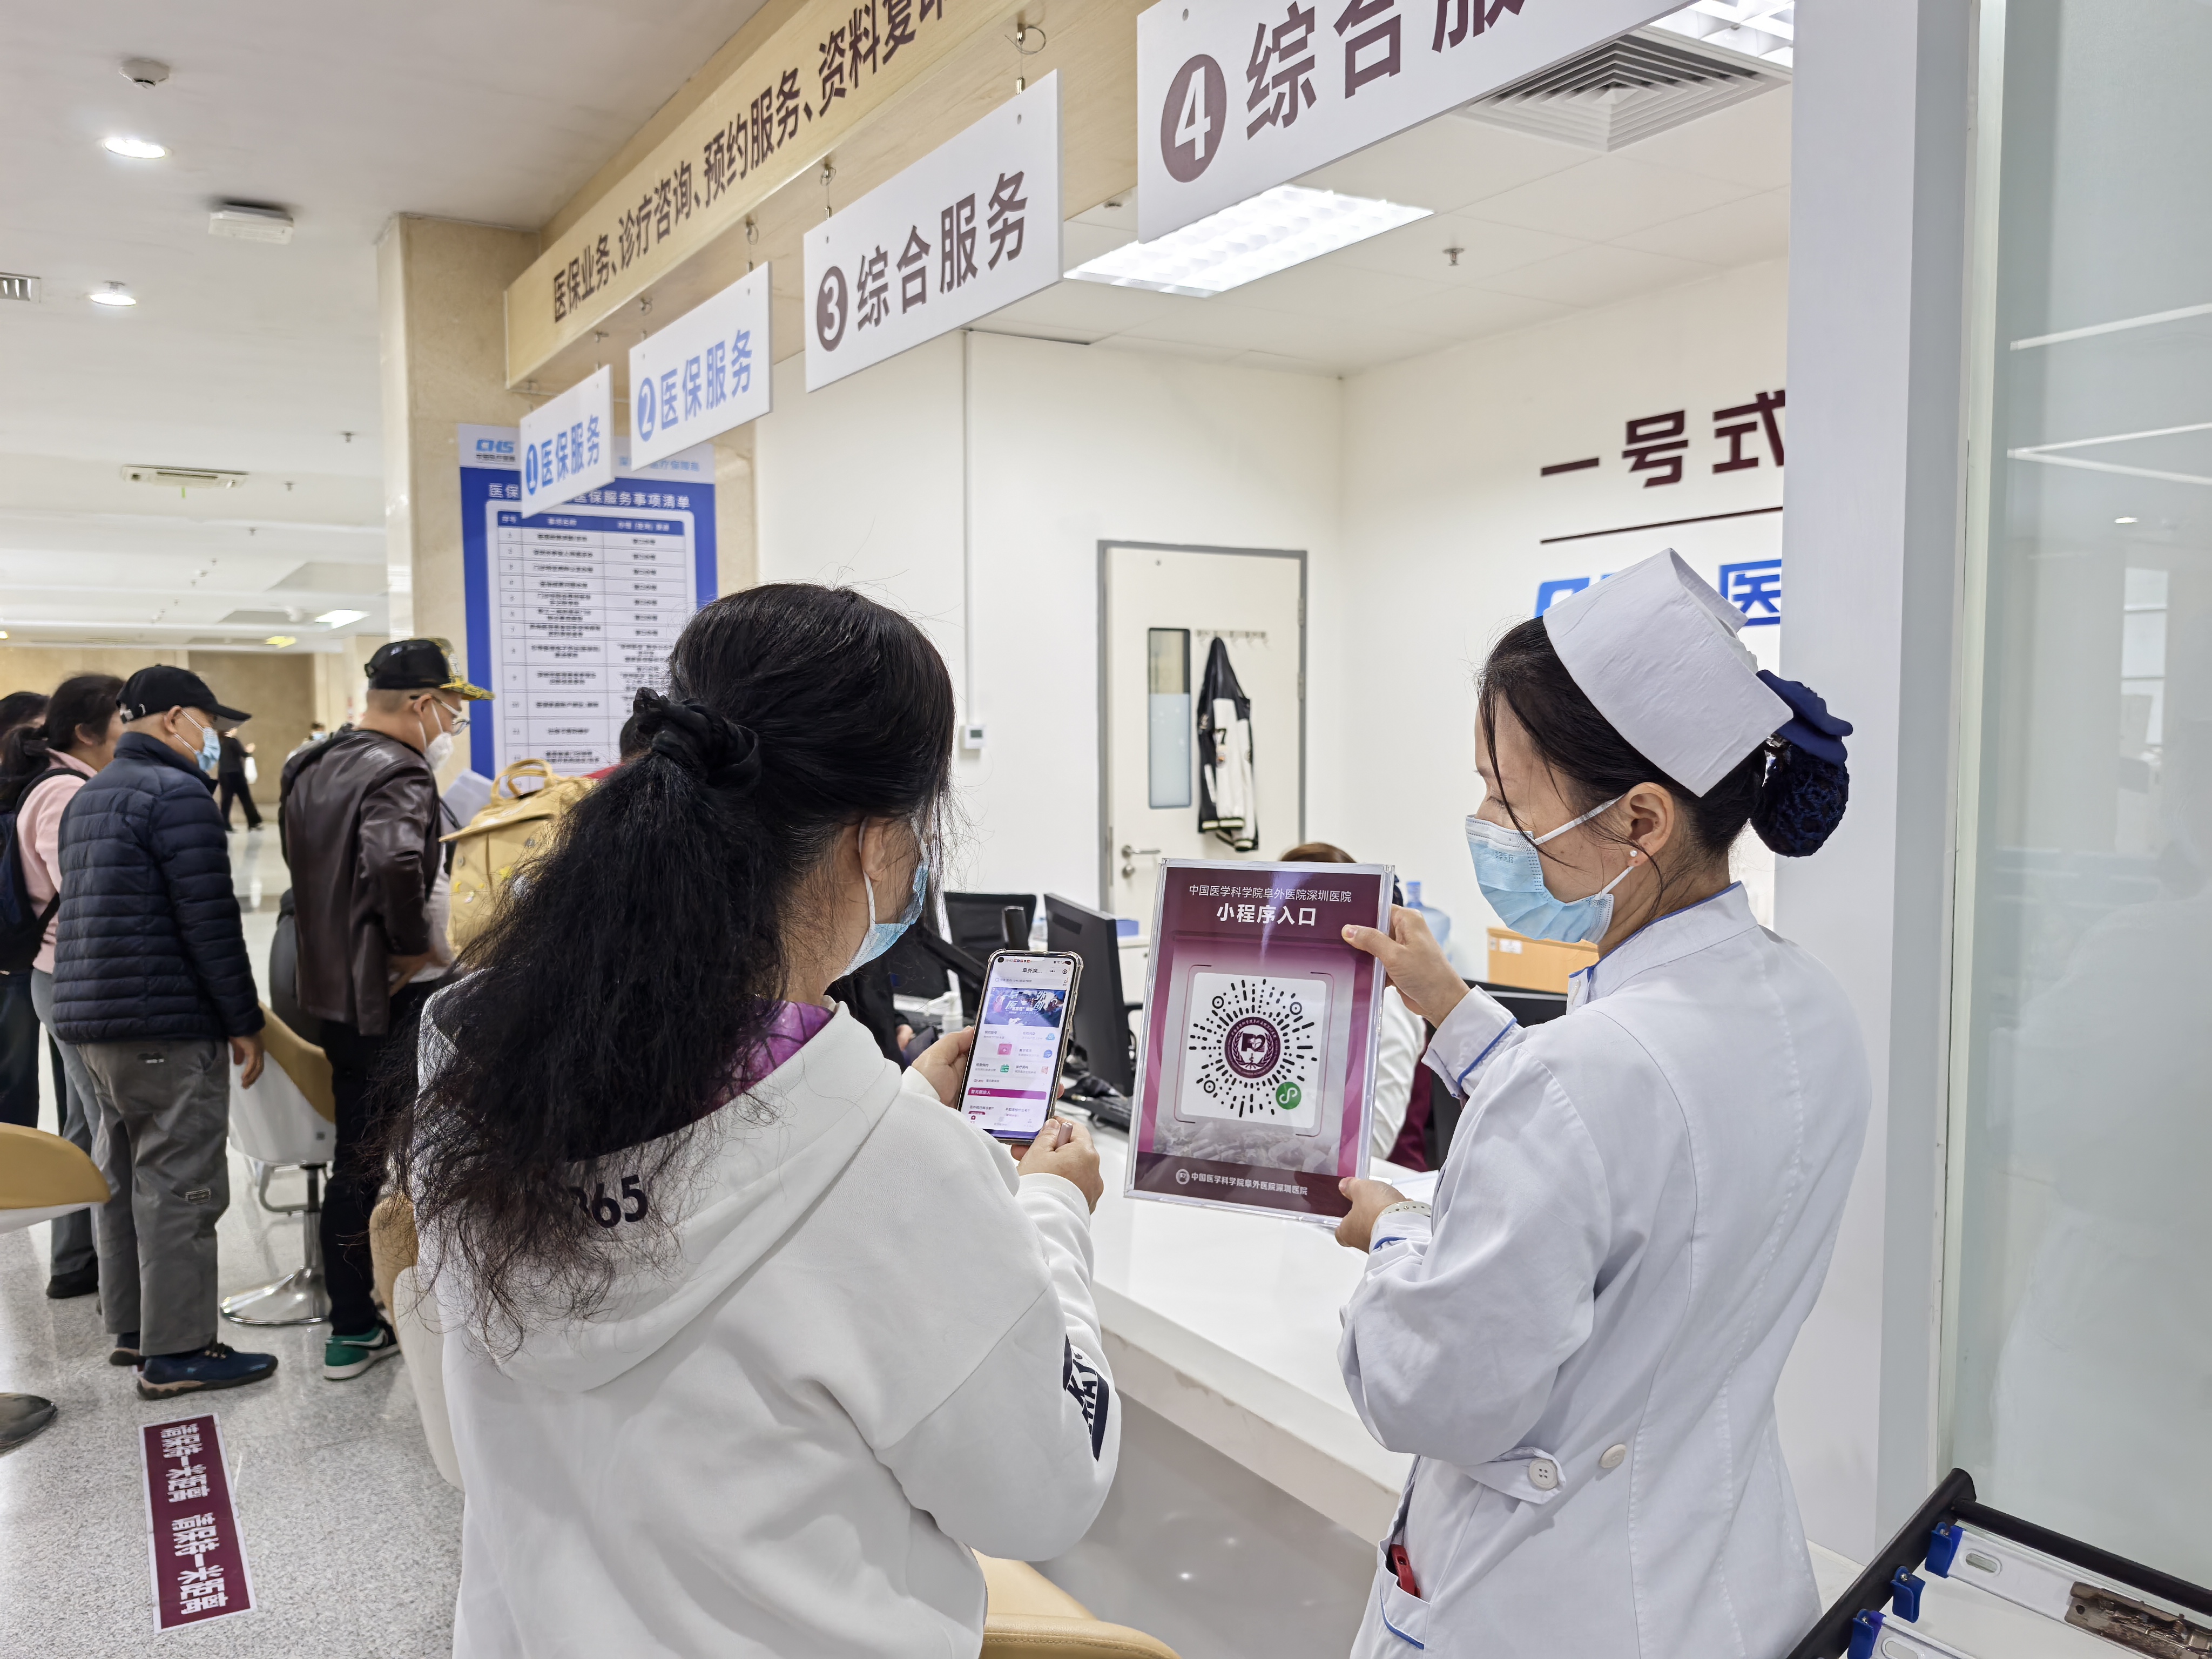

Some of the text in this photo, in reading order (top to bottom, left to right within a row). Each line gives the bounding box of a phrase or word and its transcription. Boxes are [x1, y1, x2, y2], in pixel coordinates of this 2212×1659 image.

[554, 0, 942, 323] 医保业务、诊疗咨询、预约服务、资料复
[857, 171, 1027, 332] 综合服务
[660, 329, 753, 431] 医保服务
[541, 414, 600, 487] 医保服务
[1189, 884, 1352, 902] 中国医学科学院阜外医院深圳医院
[1216, 902, 1317, 926] 小程序入口
[1191, 1172, 1308, 1196] 中国医学科学院阜外医院深圳医院
[161, 1424, 228, 1614] 请保持一米距离 请保持一米距离
